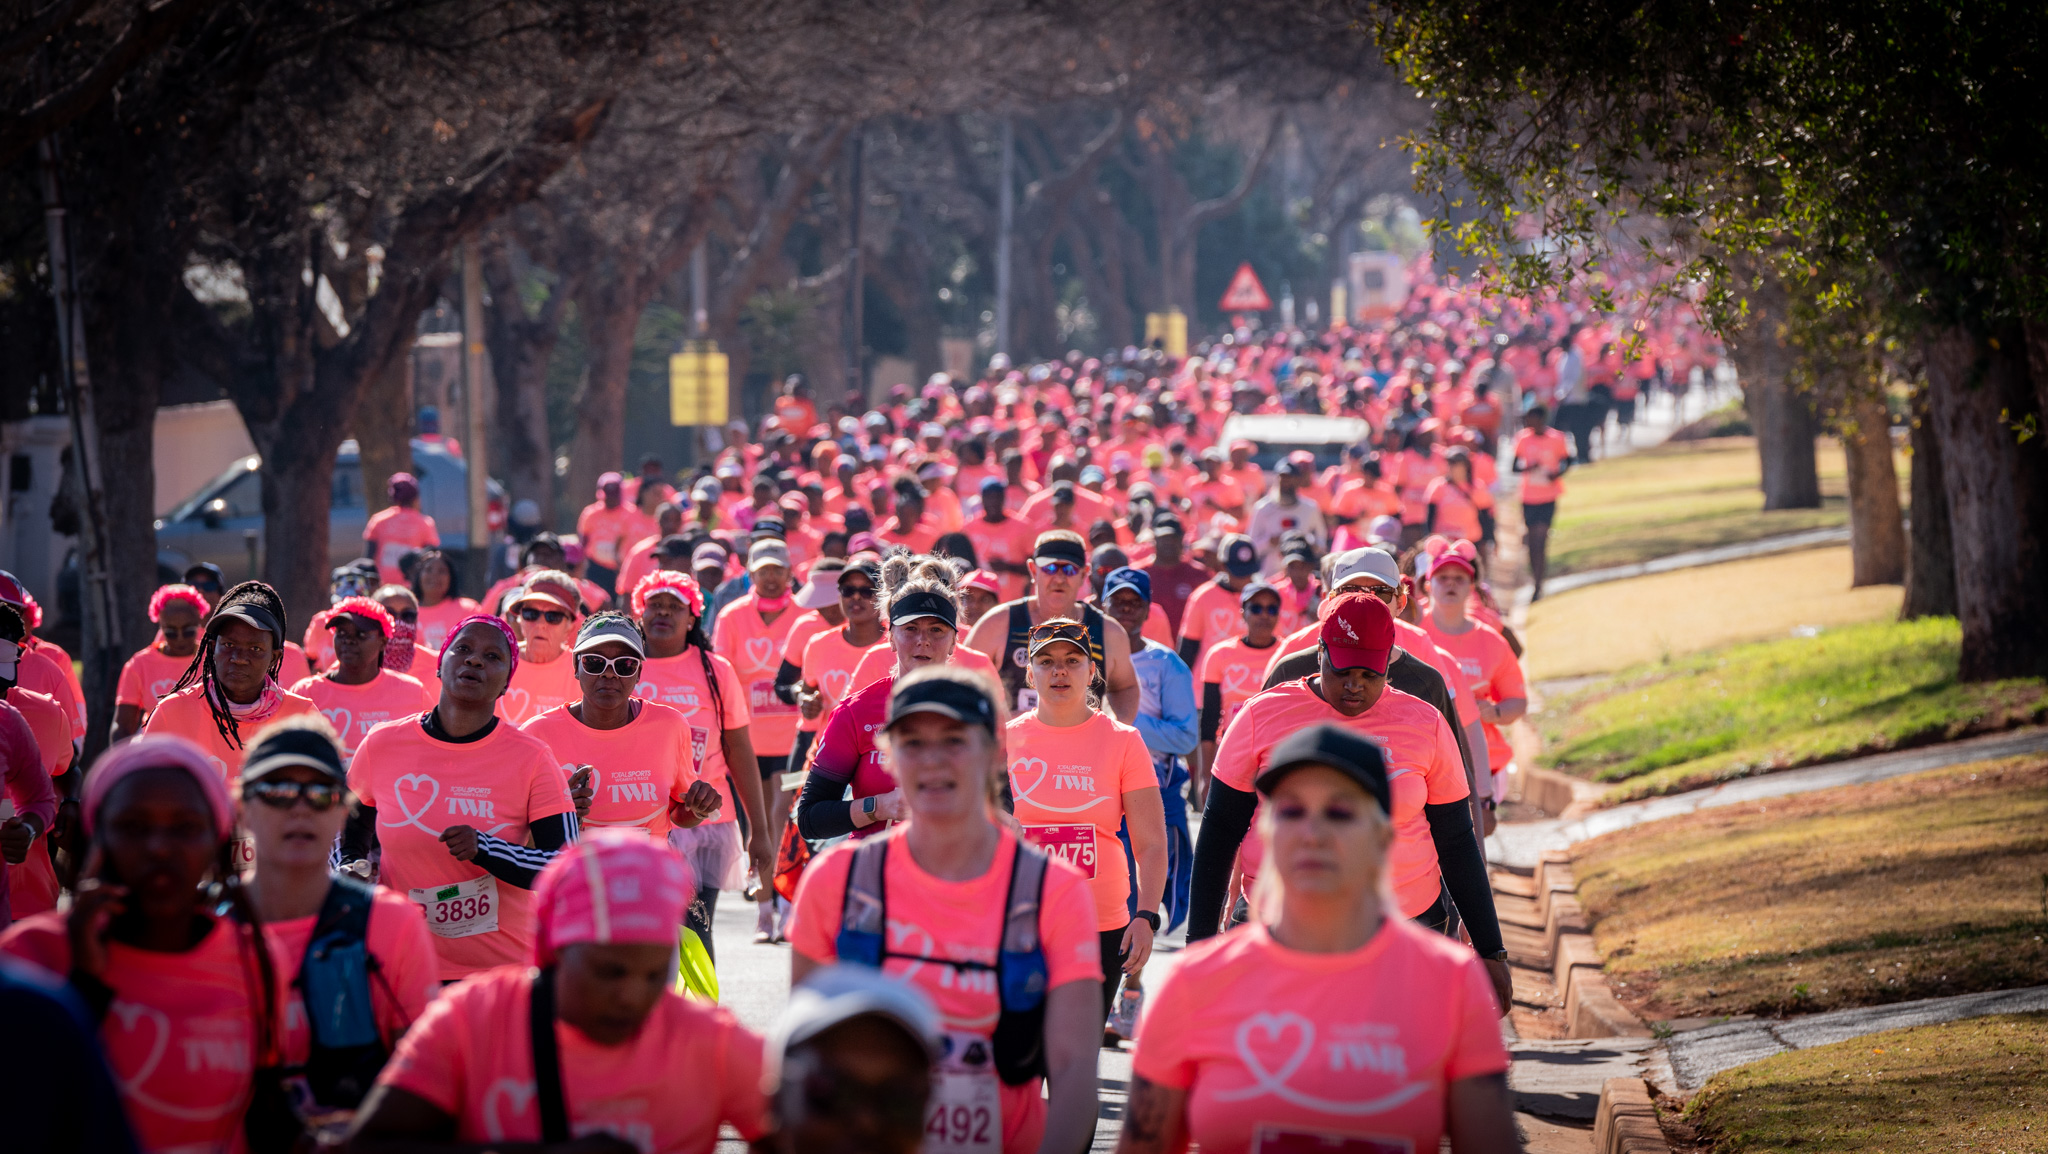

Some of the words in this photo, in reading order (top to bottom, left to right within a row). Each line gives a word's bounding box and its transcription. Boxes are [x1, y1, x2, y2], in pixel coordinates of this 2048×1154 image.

[607, 782, 659, 803] TWR
[1052, 774, 1096, 792] TWR
[444, 796, 496, 819] TWR
[435, 894, 490, 923] 3836
[926, 1104, 991, 1144] 492
